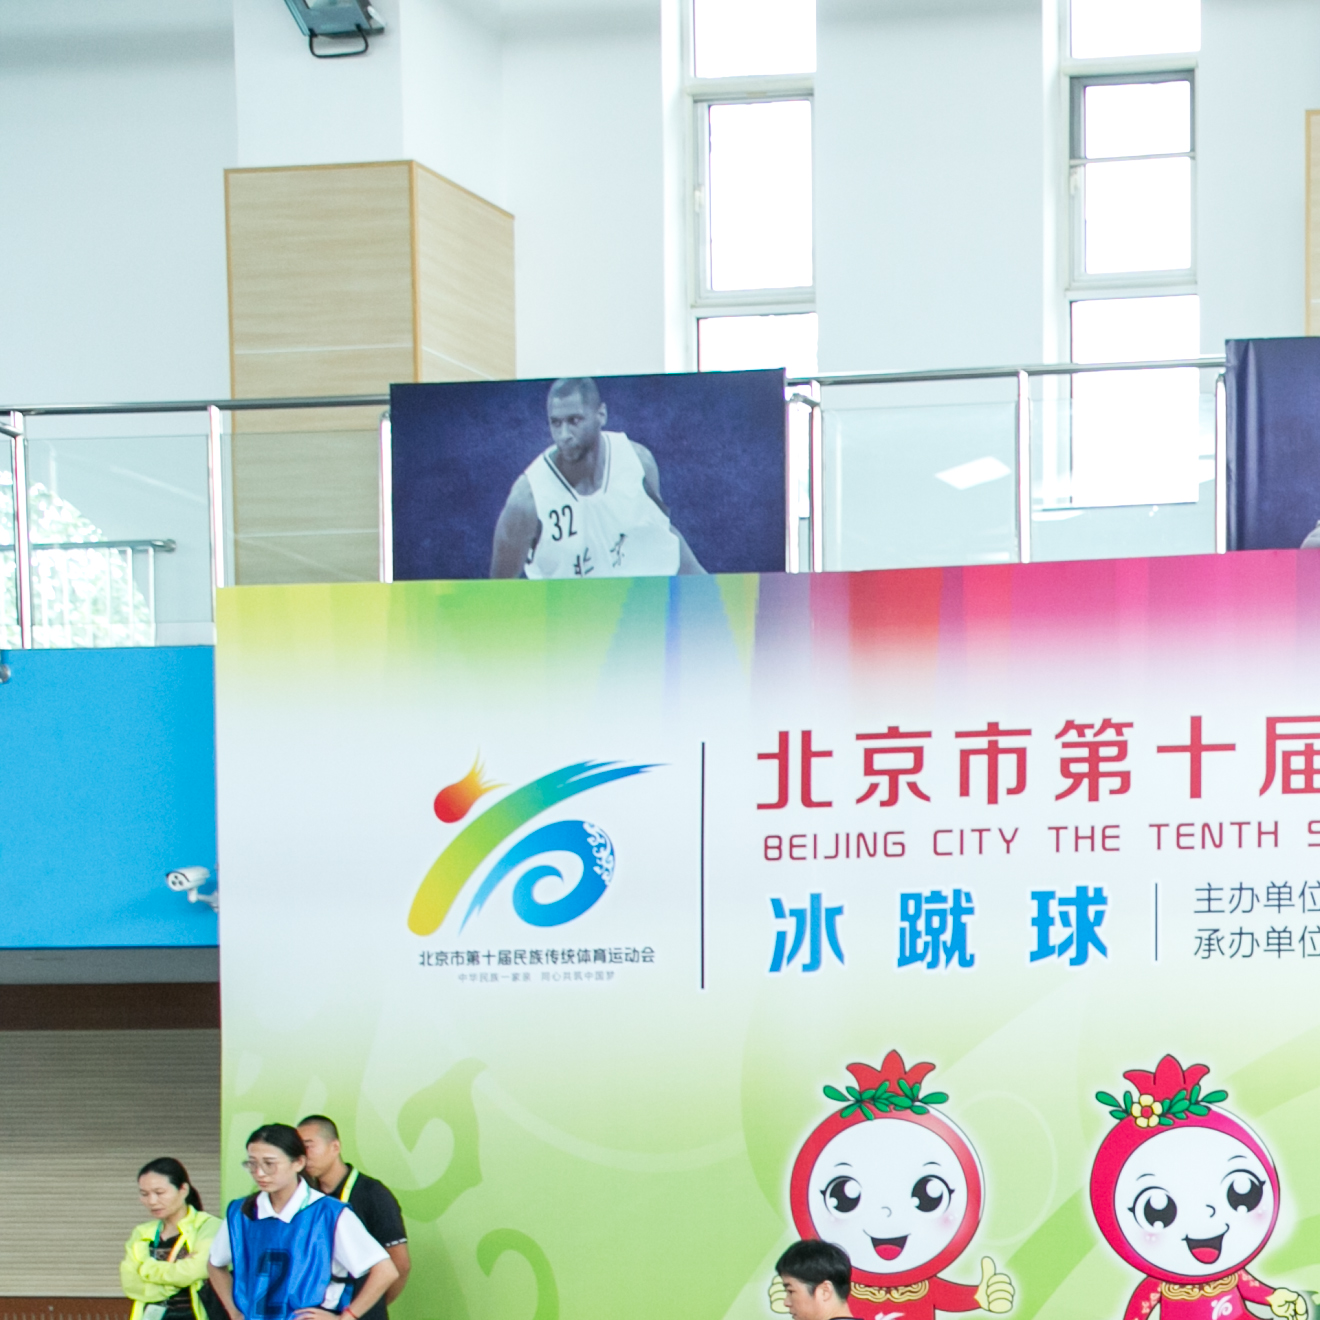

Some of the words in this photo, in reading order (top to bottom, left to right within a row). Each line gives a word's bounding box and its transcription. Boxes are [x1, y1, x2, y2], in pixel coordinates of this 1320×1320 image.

[549, 504, 578, 542] 32
[763, 830, 907, 861] BEIJING
[933, 826, 1020, 857] CITY
[1047, 824, 1121, 853] THE
[1149, 820, 1280, 851] TENTH
[768, 884, 1109, 974] 冰蹴球
[418, 946, 656, 967] 北京市第十届民族传统体育运动会
[255, 1249, 290, 1318] 2
